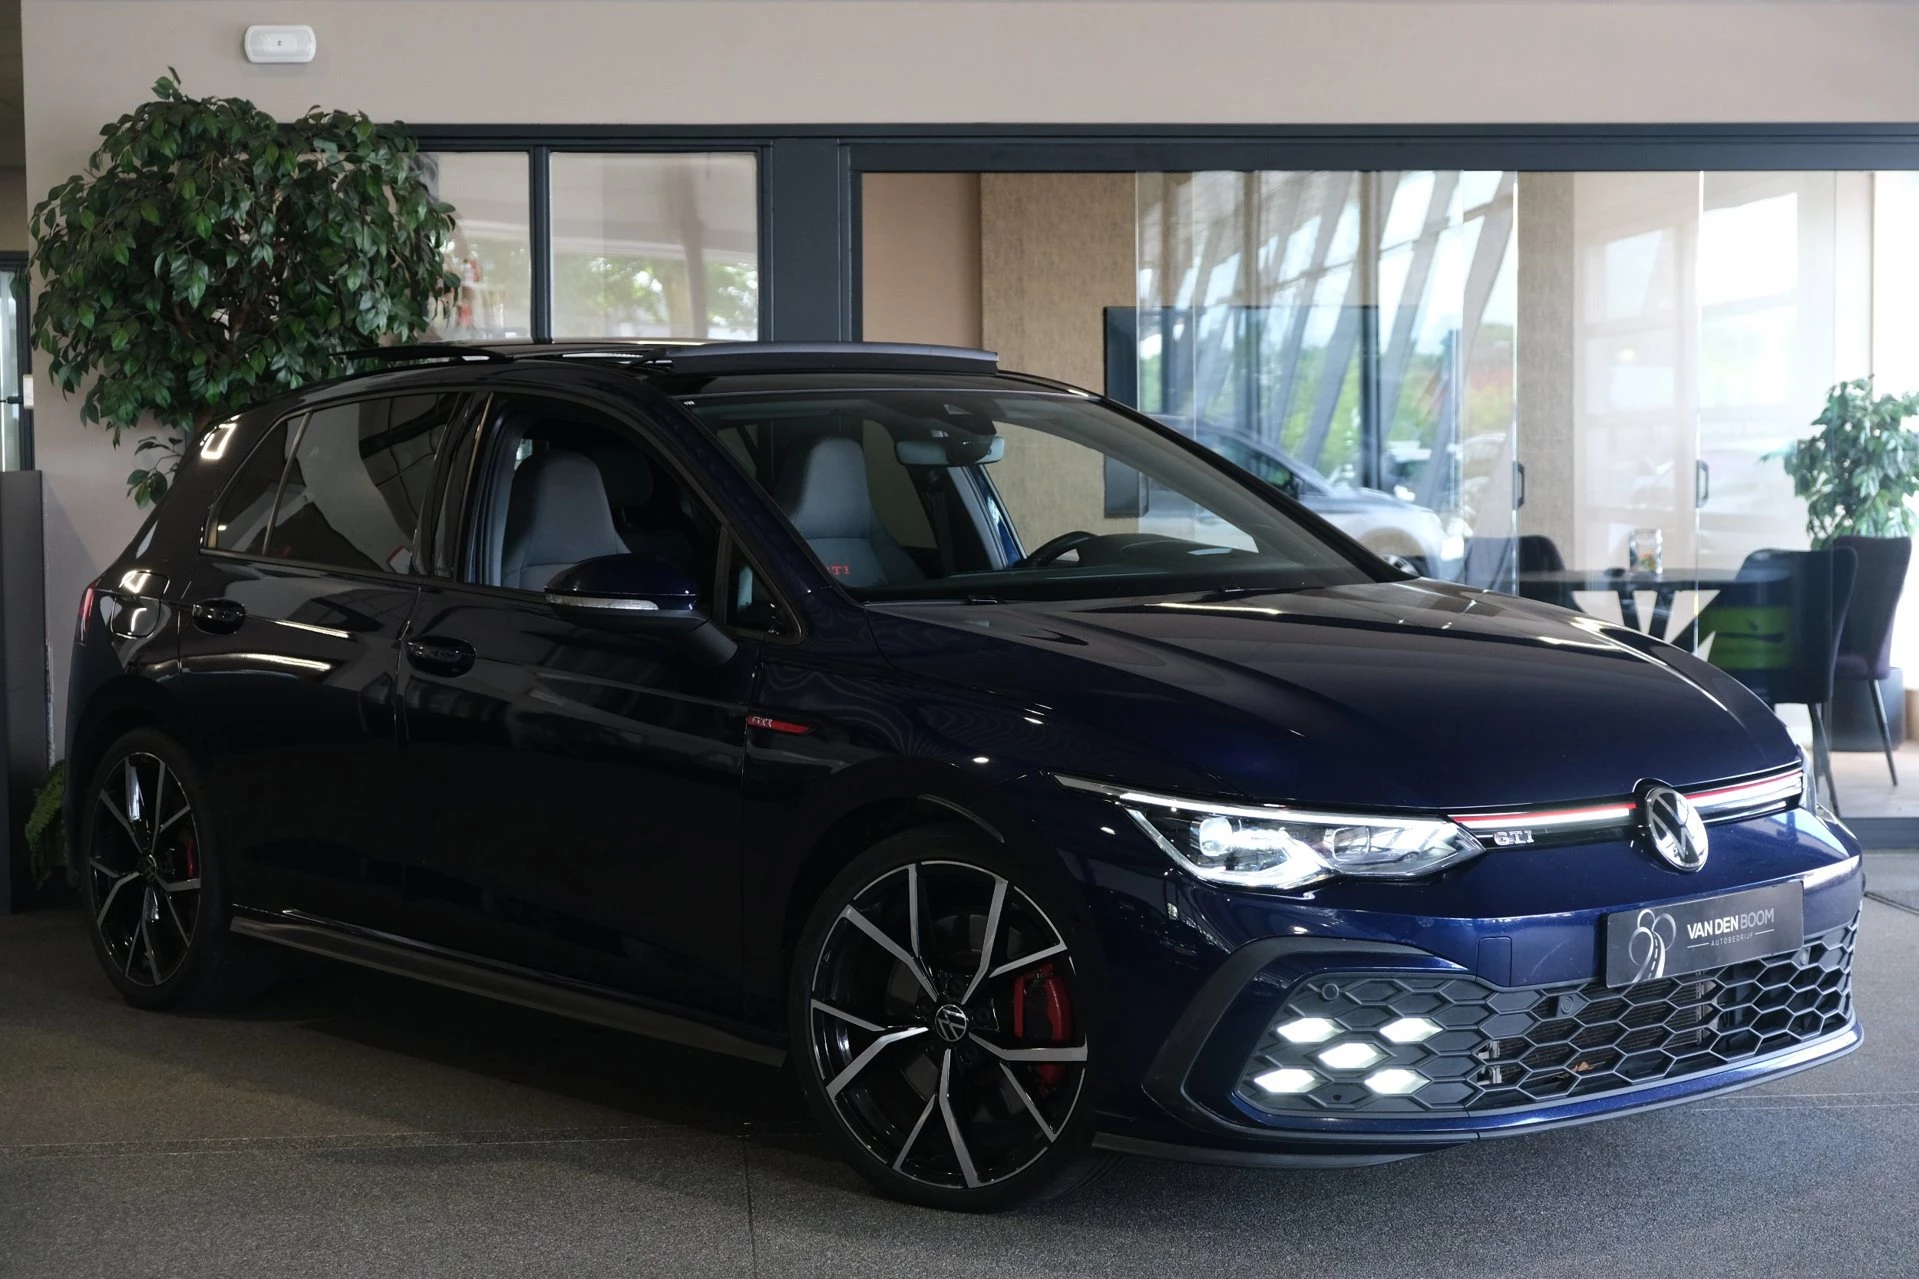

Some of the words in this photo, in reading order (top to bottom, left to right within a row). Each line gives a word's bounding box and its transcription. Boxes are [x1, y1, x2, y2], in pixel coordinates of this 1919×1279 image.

[1493, 830, 1535, 846] GTI
[1687, 920, 1713, 939] VAN
[1714, 915, 1739, 935] DEN
[1740, 908, 1774, 929] BOOM
[1710, 932, 1754, 947] AUTOBEDRIJF
